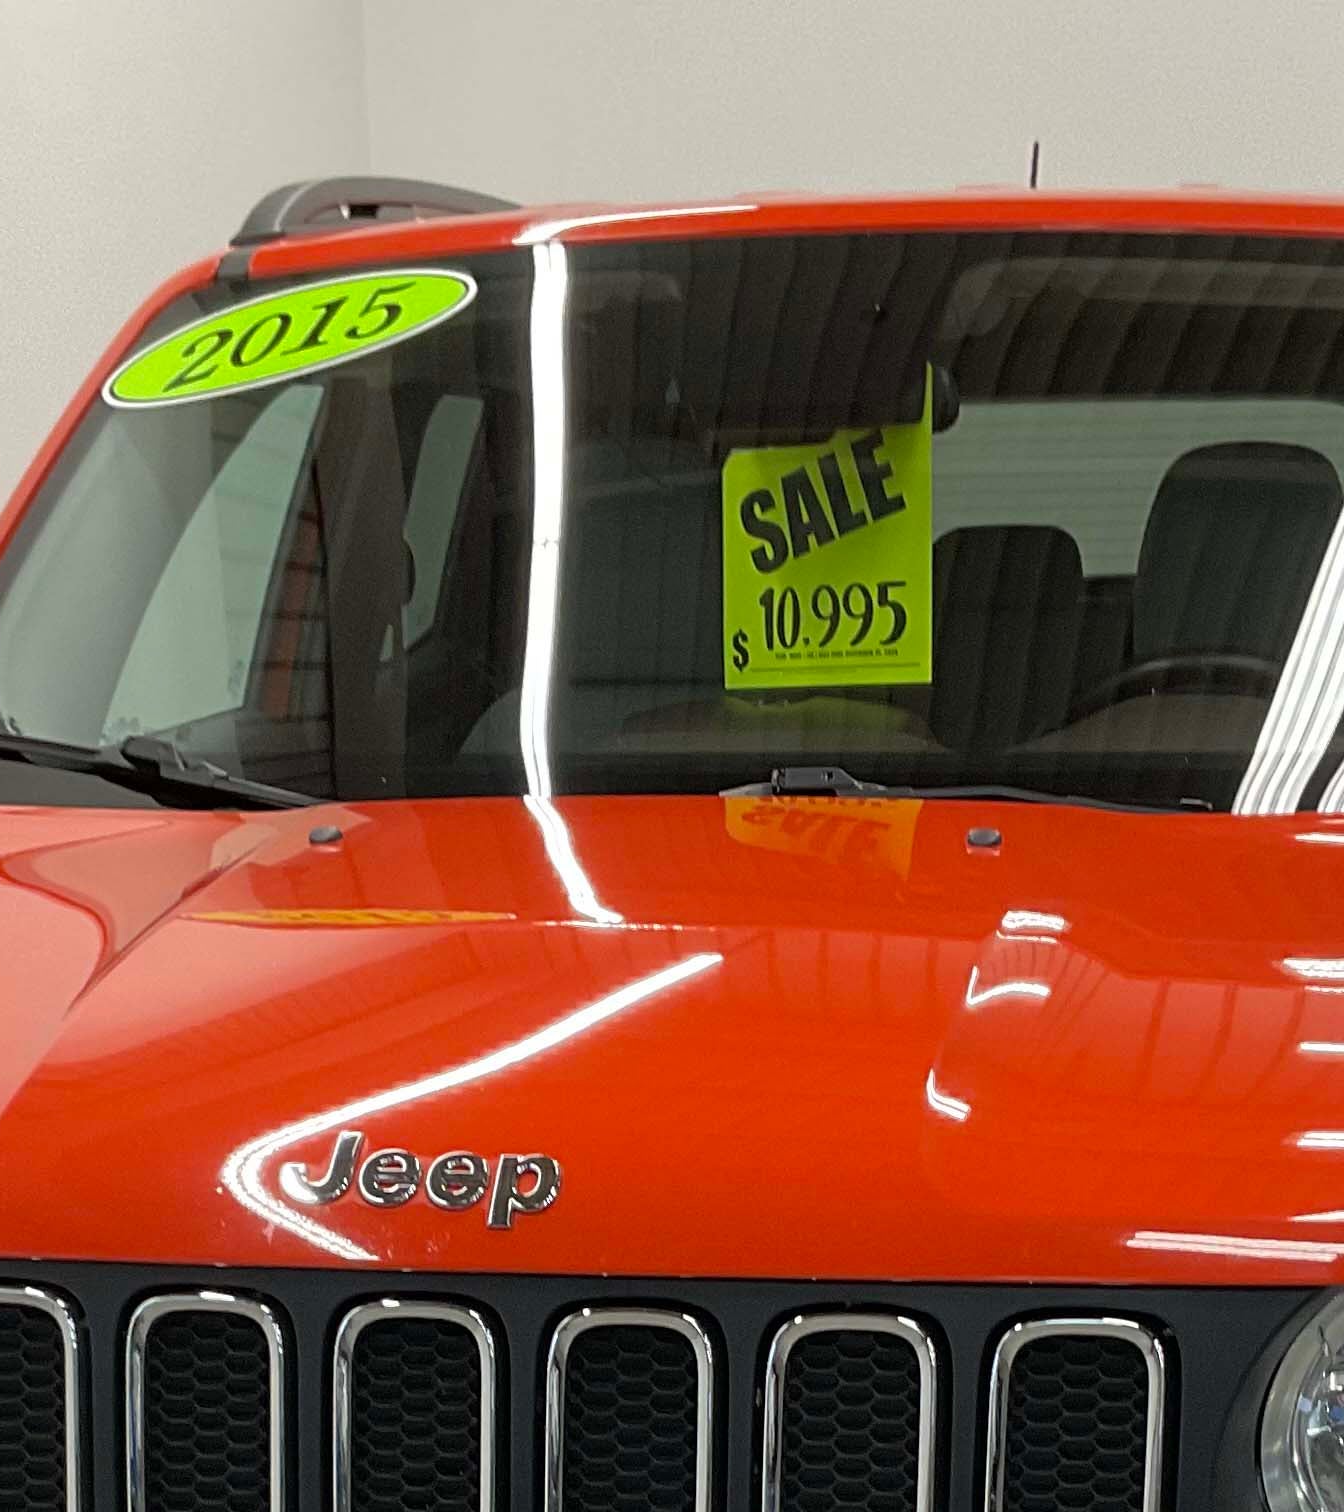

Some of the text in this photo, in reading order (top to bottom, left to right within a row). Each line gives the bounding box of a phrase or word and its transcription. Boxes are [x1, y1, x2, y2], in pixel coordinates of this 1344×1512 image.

[163, 281, 417, 393] 2015
[740, 429, 907, 575] SALE
[279, 1130, 561, 1230] Jeep
